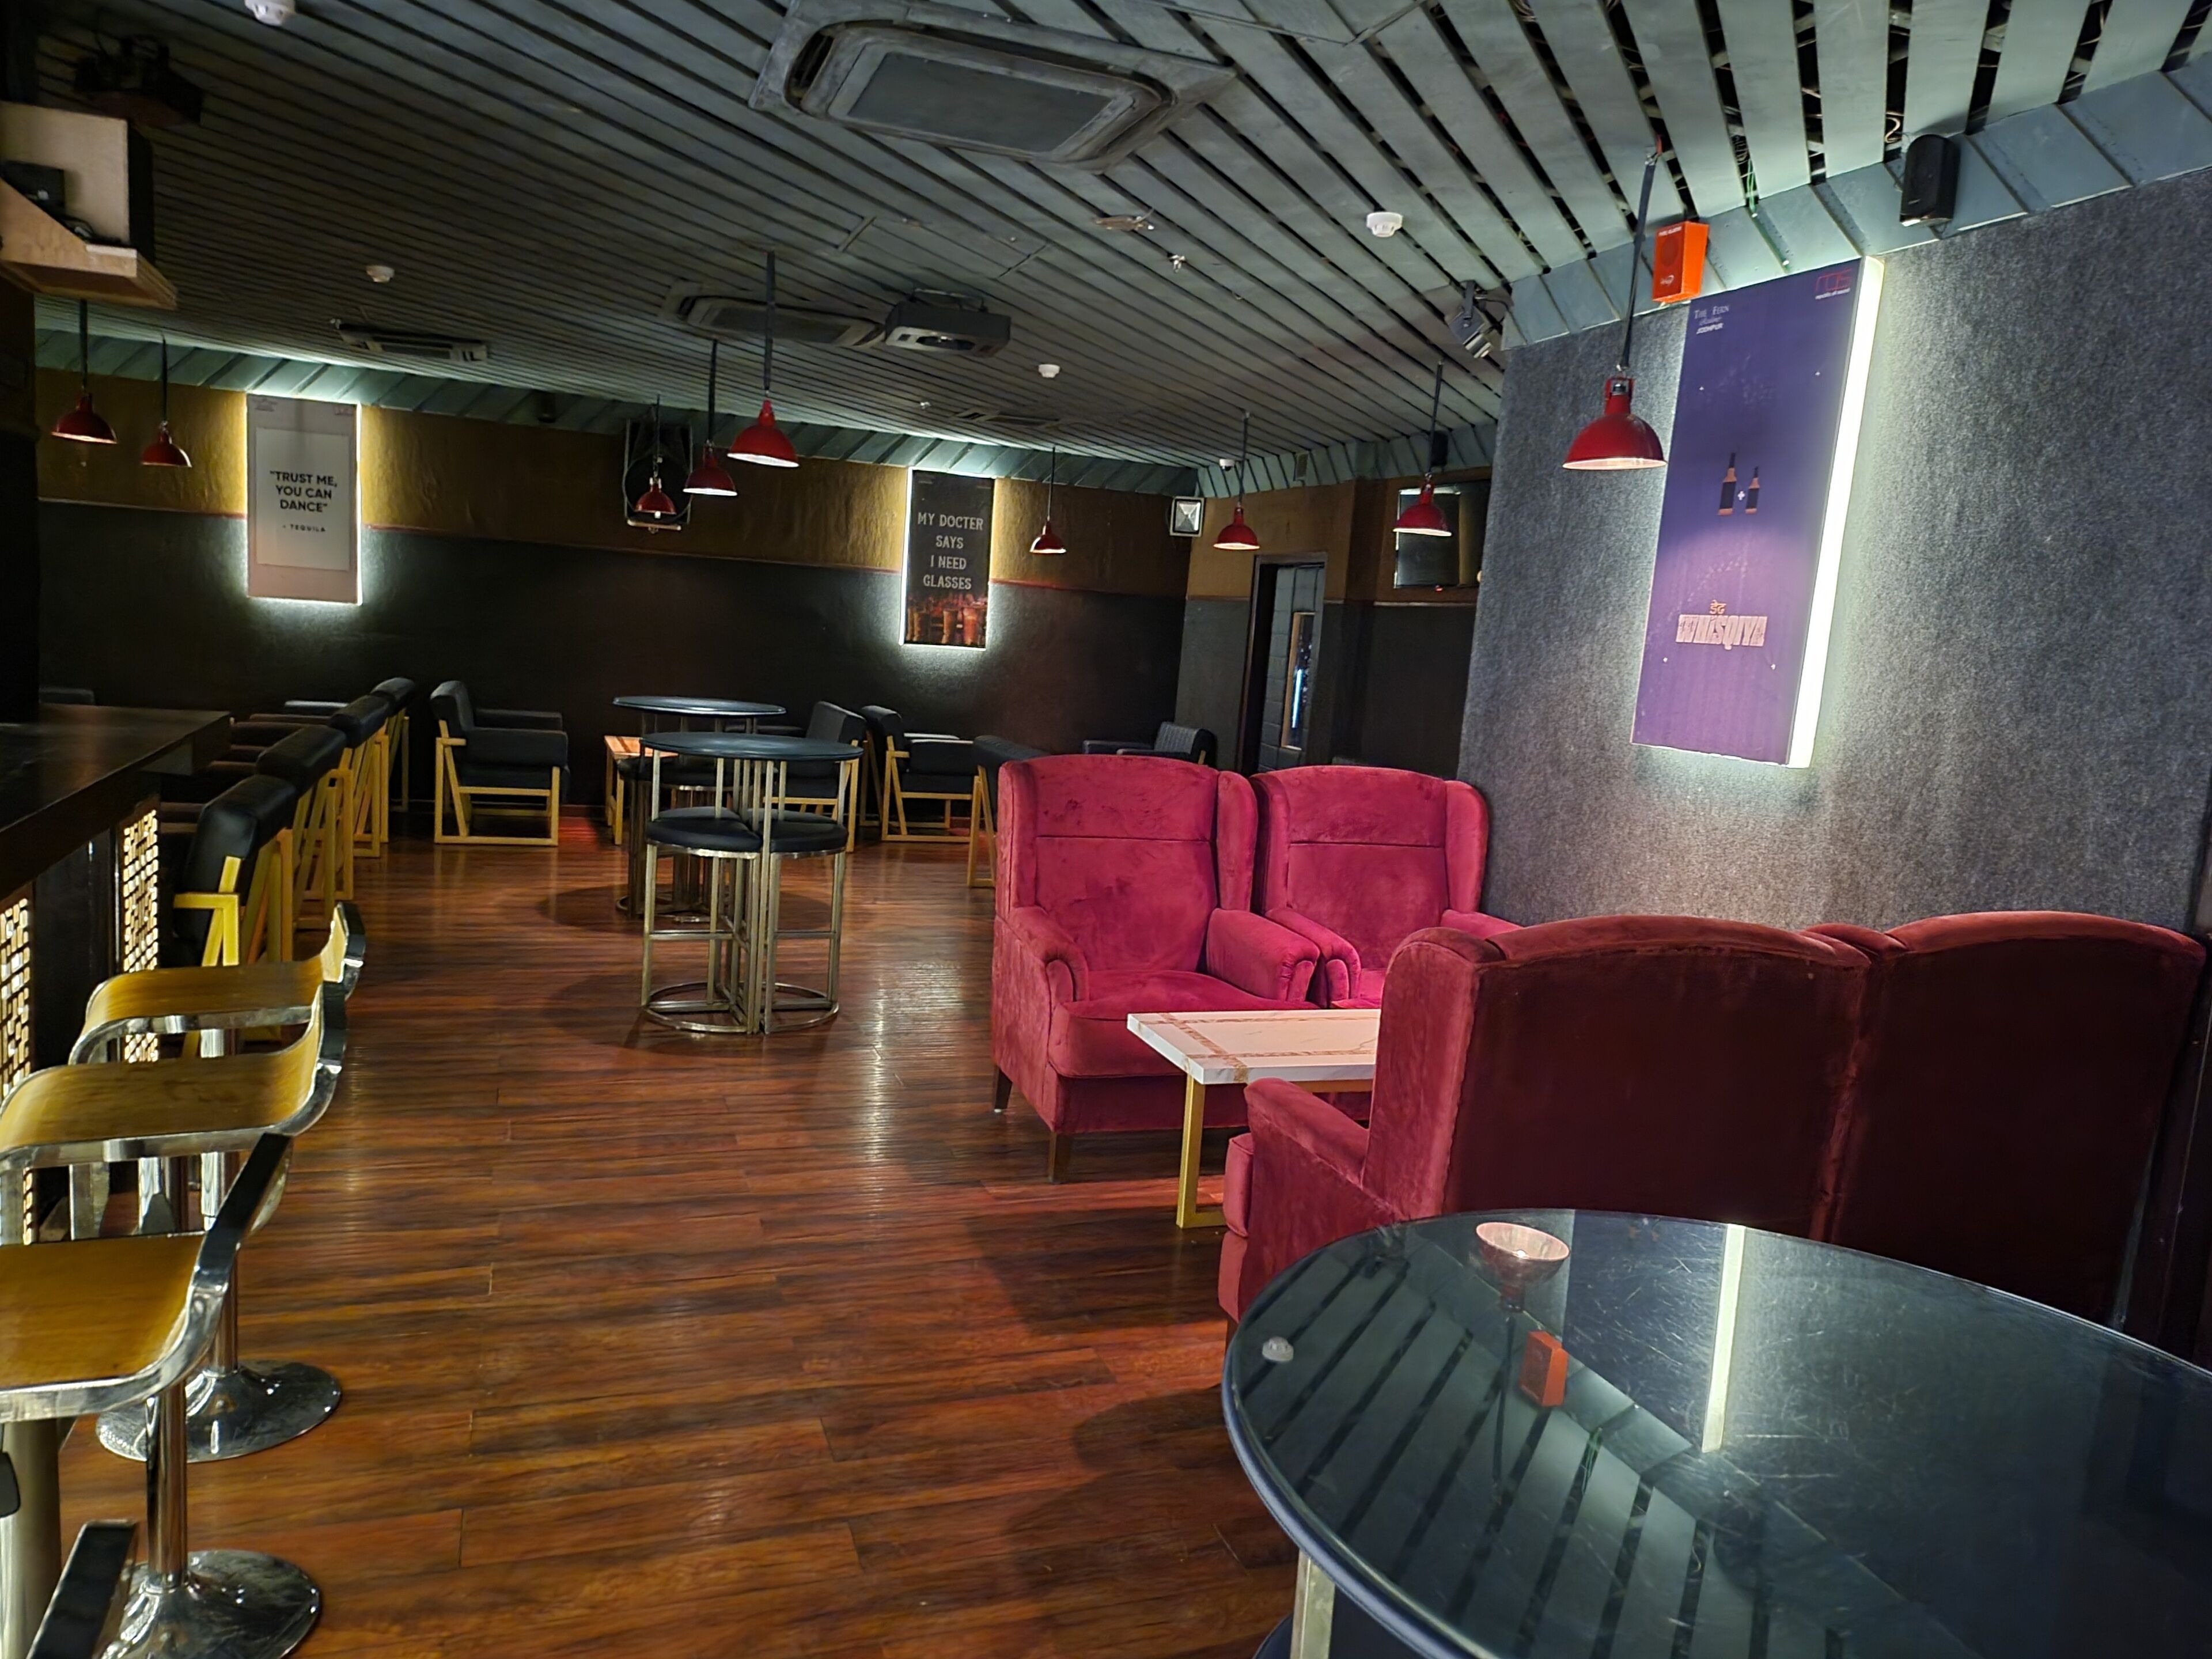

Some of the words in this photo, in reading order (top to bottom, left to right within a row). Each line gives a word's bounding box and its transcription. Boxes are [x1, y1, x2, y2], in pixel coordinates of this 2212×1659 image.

[317, 475, 337, 487] ME,
[276, 485, 301, 497] YOU
[305, 488, 332, 499] CAN
[290, 524, 325, 532] TEQUILA
[918, 512, 935, 525] MY
[940, 514, 984, 531] DOCTER
[935, 535, 964, 550] SAYS
[930, 555, 934, 567] I
[938, 556, 967, 570] NEED
[923, 574, 972, 590] GLASSES
